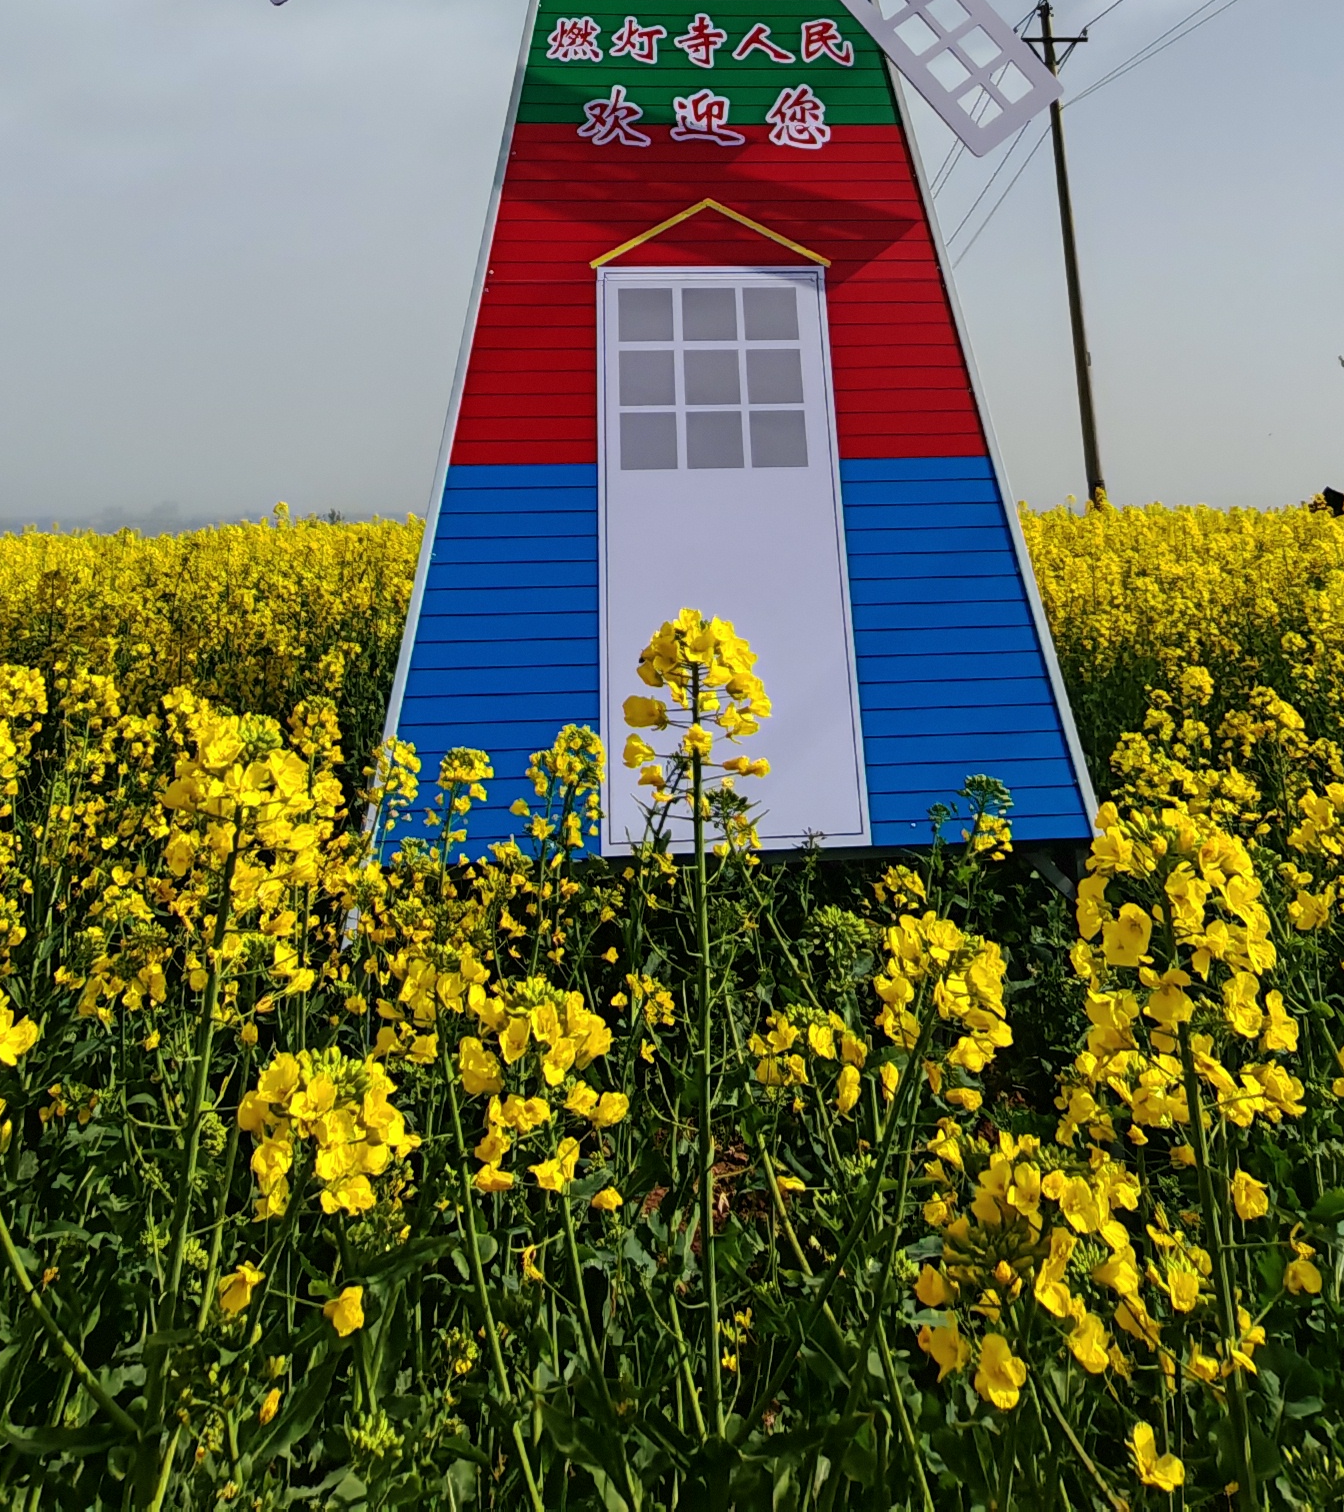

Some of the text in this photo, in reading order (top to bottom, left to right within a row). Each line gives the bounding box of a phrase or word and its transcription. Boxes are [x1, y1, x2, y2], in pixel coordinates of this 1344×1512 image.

[548, 15, 853, 66] 燃灯寺人民
[580, 86, 829, 148] 欢迎您
